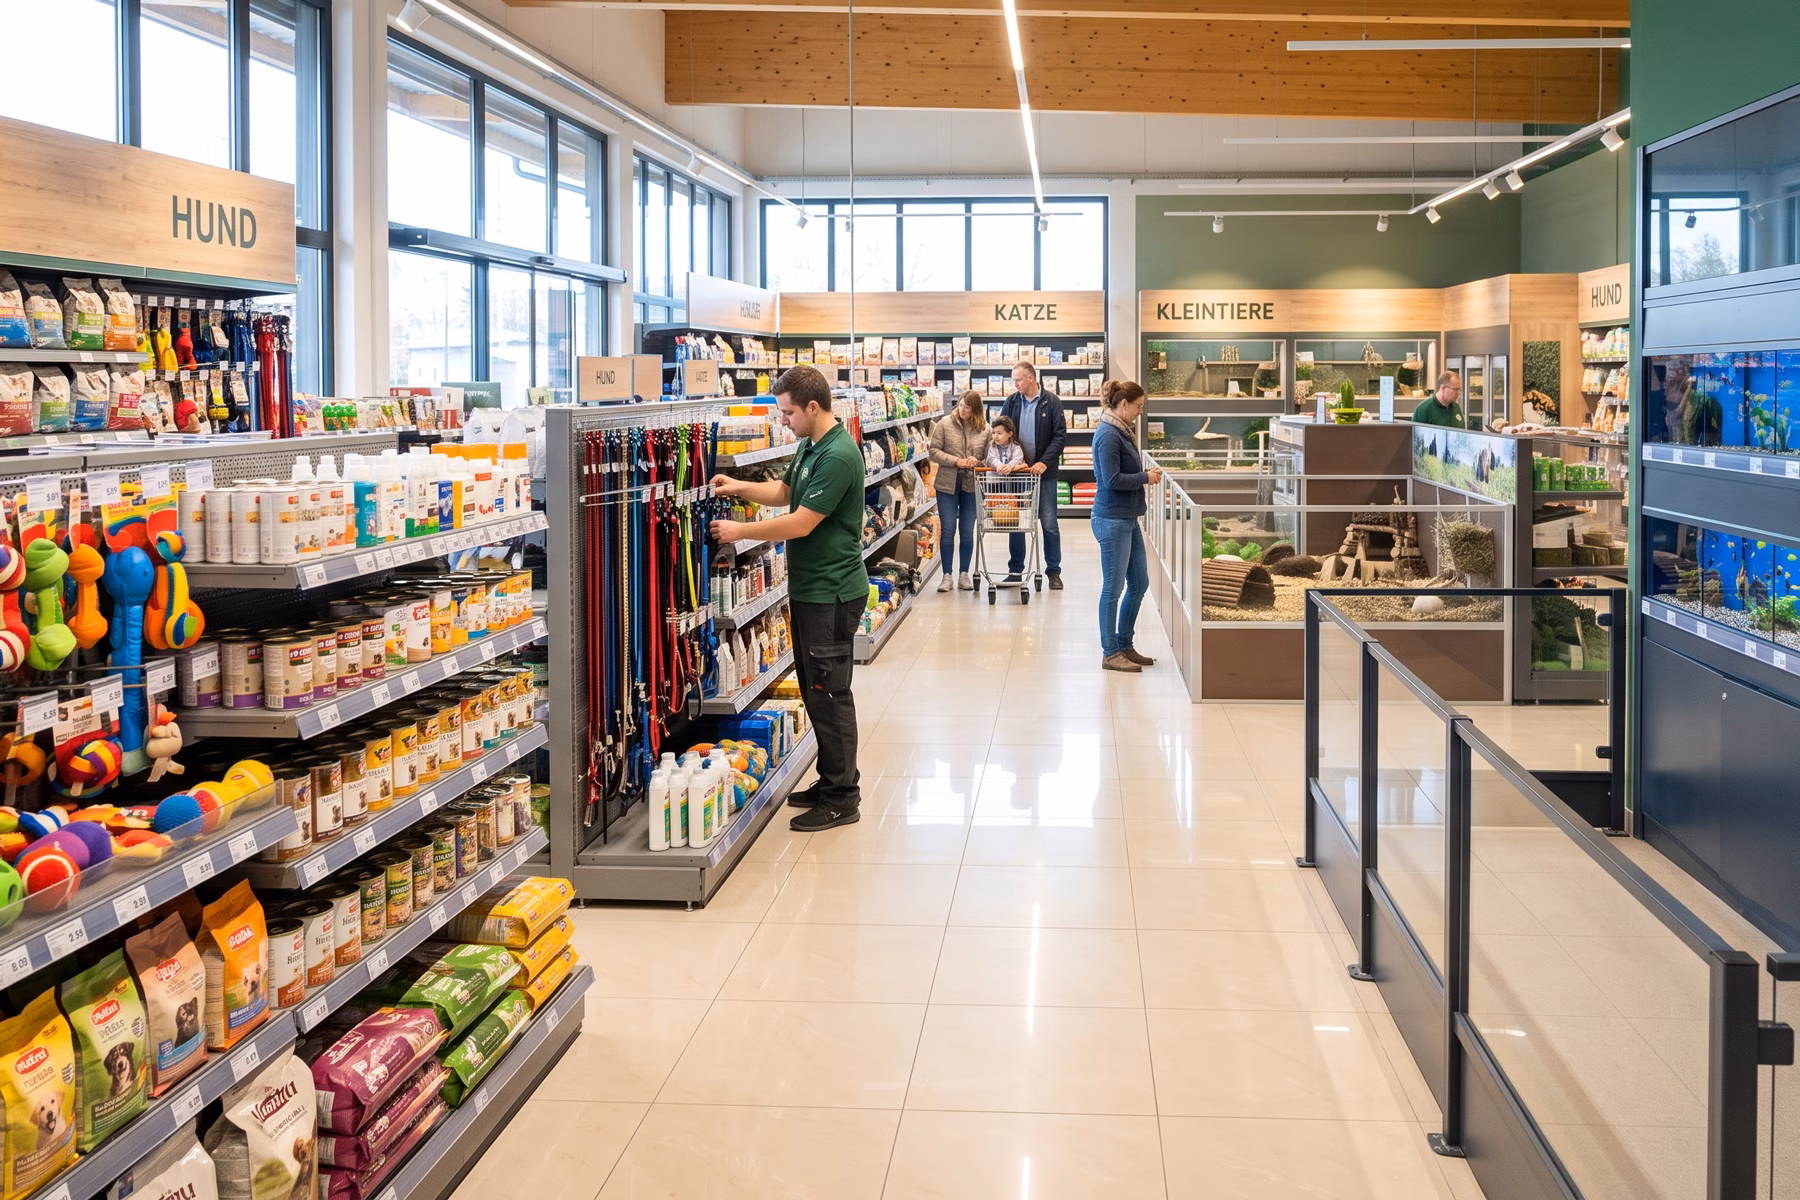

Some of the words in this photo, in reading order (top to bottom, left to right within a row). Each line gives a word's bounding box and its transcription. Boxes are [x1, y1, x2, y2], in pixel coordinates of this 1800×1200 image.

[172, 194, 257, 249] HUND
[1591, 282, 1622, 308] HUND
[994, 303, 1057, 321] KATZE
[1157, 302, 1274, 320] KLEINTIERE
[595, 370, 615, 385] HUND
